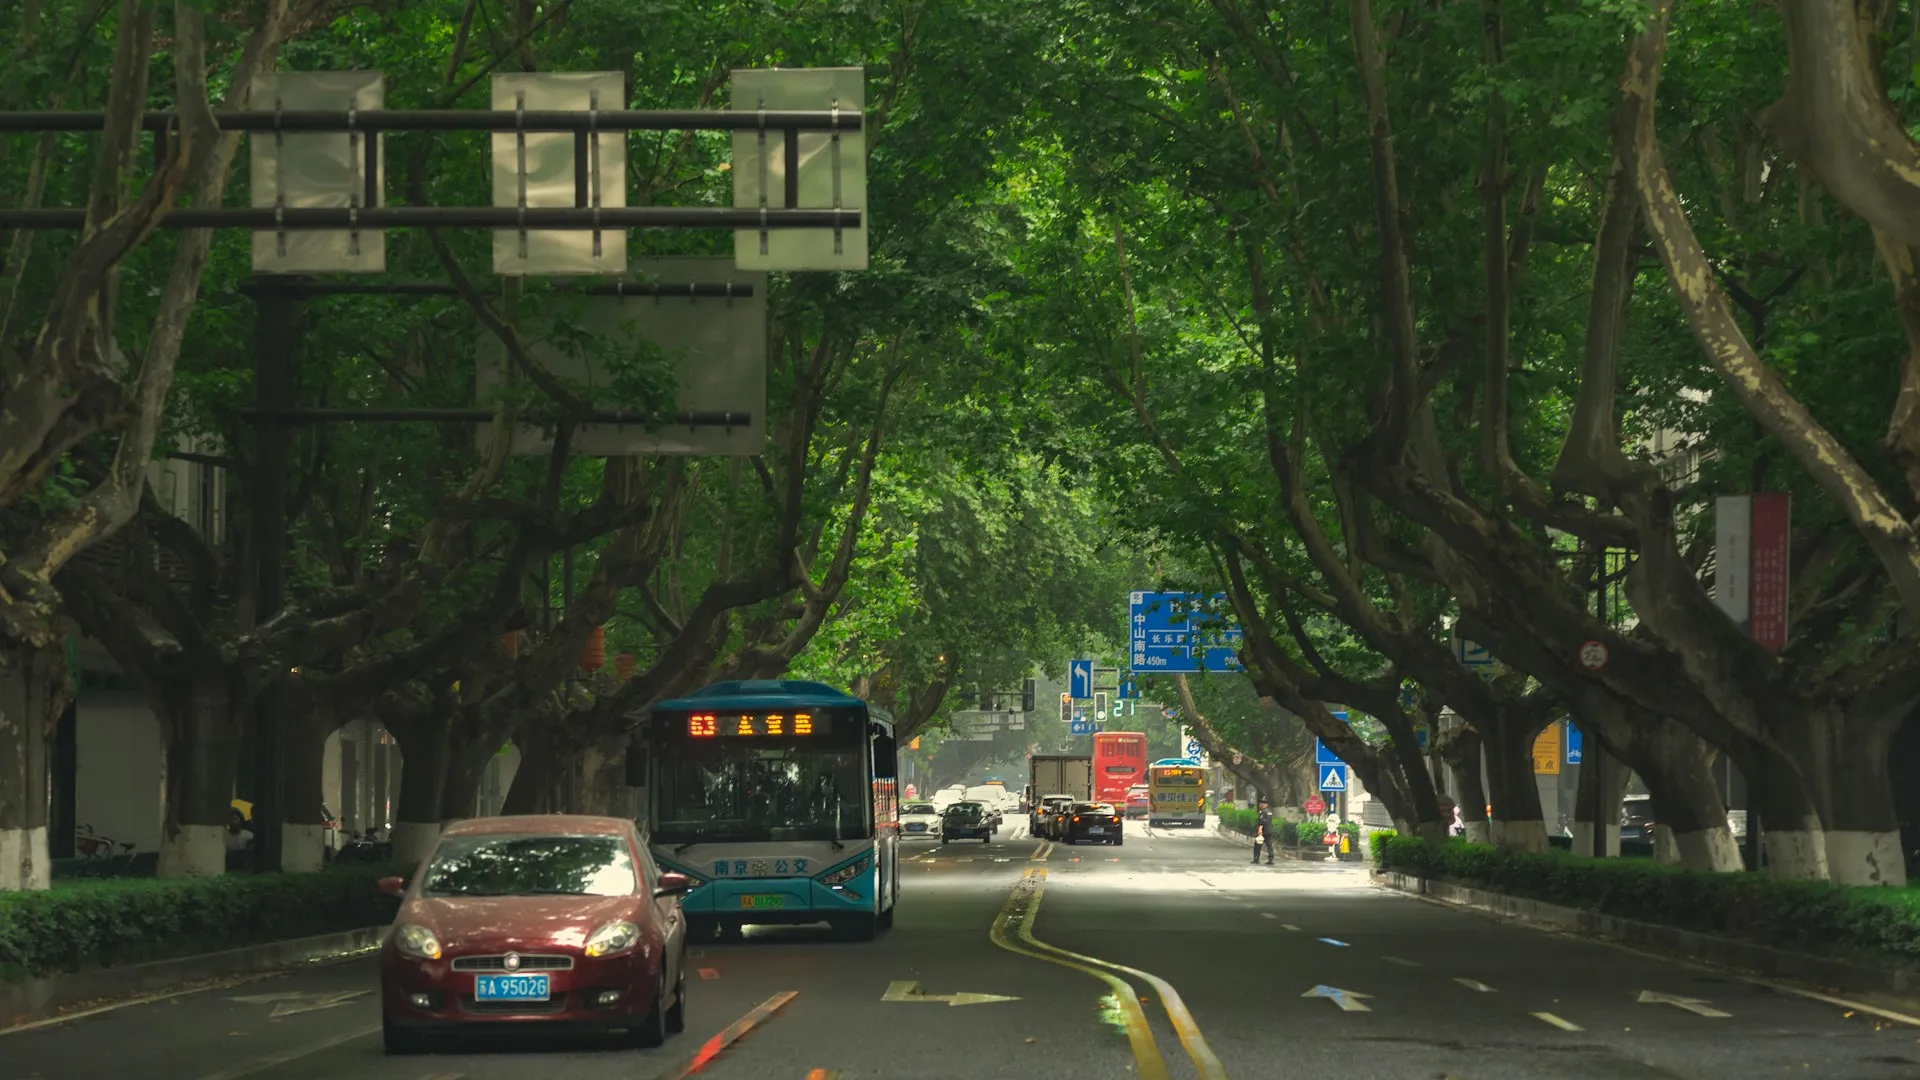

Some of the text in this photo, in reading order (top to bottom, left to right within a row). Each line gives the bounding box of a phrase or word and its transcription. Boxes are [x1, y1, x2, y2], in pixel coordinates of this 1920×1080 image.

[1134, 613, 1146, 666] 中山南路
[1146, 656, 1167, 667] 450m
[1113, 700, 1135, 717] 21
[714, 858, 809, 876] 南京 公交
[479, 979, 496, 996] 苏A
